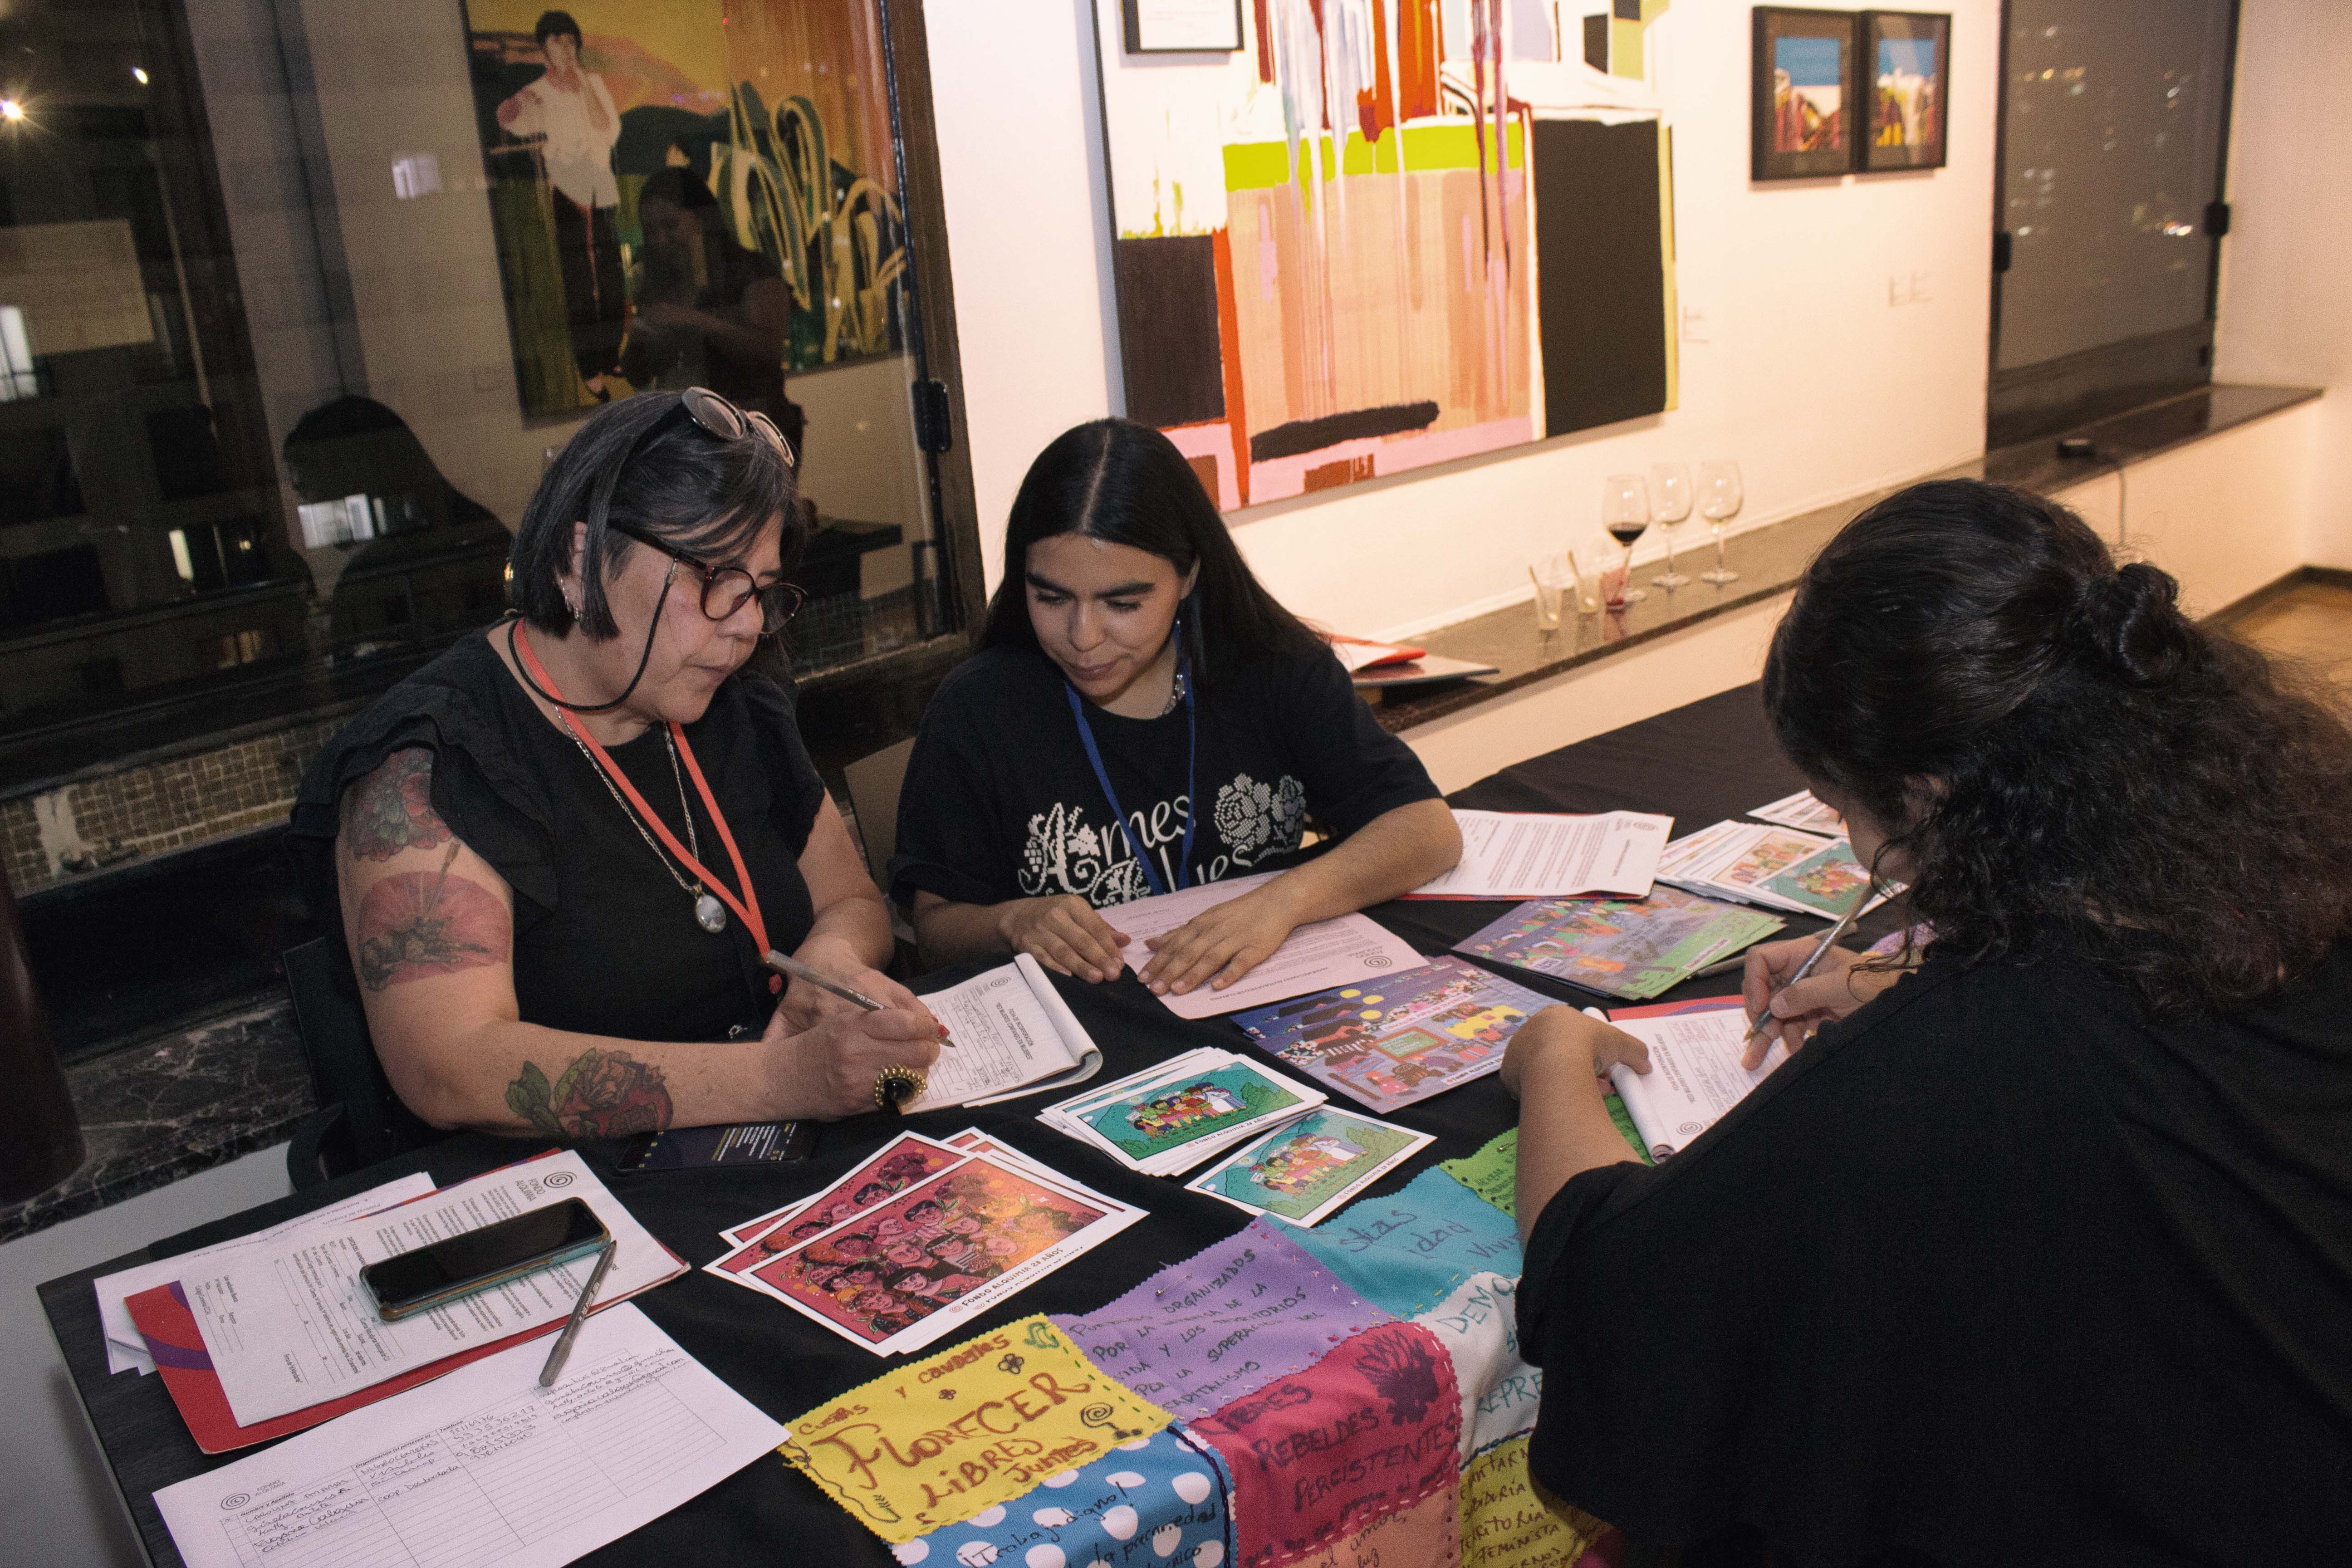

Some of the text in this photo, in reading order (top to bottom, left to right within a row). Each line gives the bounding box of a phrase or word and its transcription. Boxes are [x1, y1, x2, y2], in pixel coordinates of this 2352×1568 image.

[513, 1179, 539, 1201] ALQUIMIA
[526, 1178, 547, 1195] FONDO
[962, 1288, 992, 1307] FONDO
[993, 1266, 1031, 1289] ALQUIMIA
[1044, 1247, 1064, 1262] AÑOS
[1162, 1249, 1257, 1314] ORGANIZADOS
[1093, 1341, 1130, 1362] POR
[1137, 1325, 1155, 1338] LA
[1225, 1298, 1243, 1310] DE
[1250, 1283, 1268, 1298] LA
[1180, 1325, 1207, 1344] LOS
[240, 1504, 266, 1518] Nombre
[269, 1491, 295, 1505] Apellido
[354, 1450, 392, 1468] Organización
[439, 1420, 464, 1432] Teléfono
[254, 1480, 286, 1497] ALQUIMIA
[256, 1479, 281, 1492] FONDO
